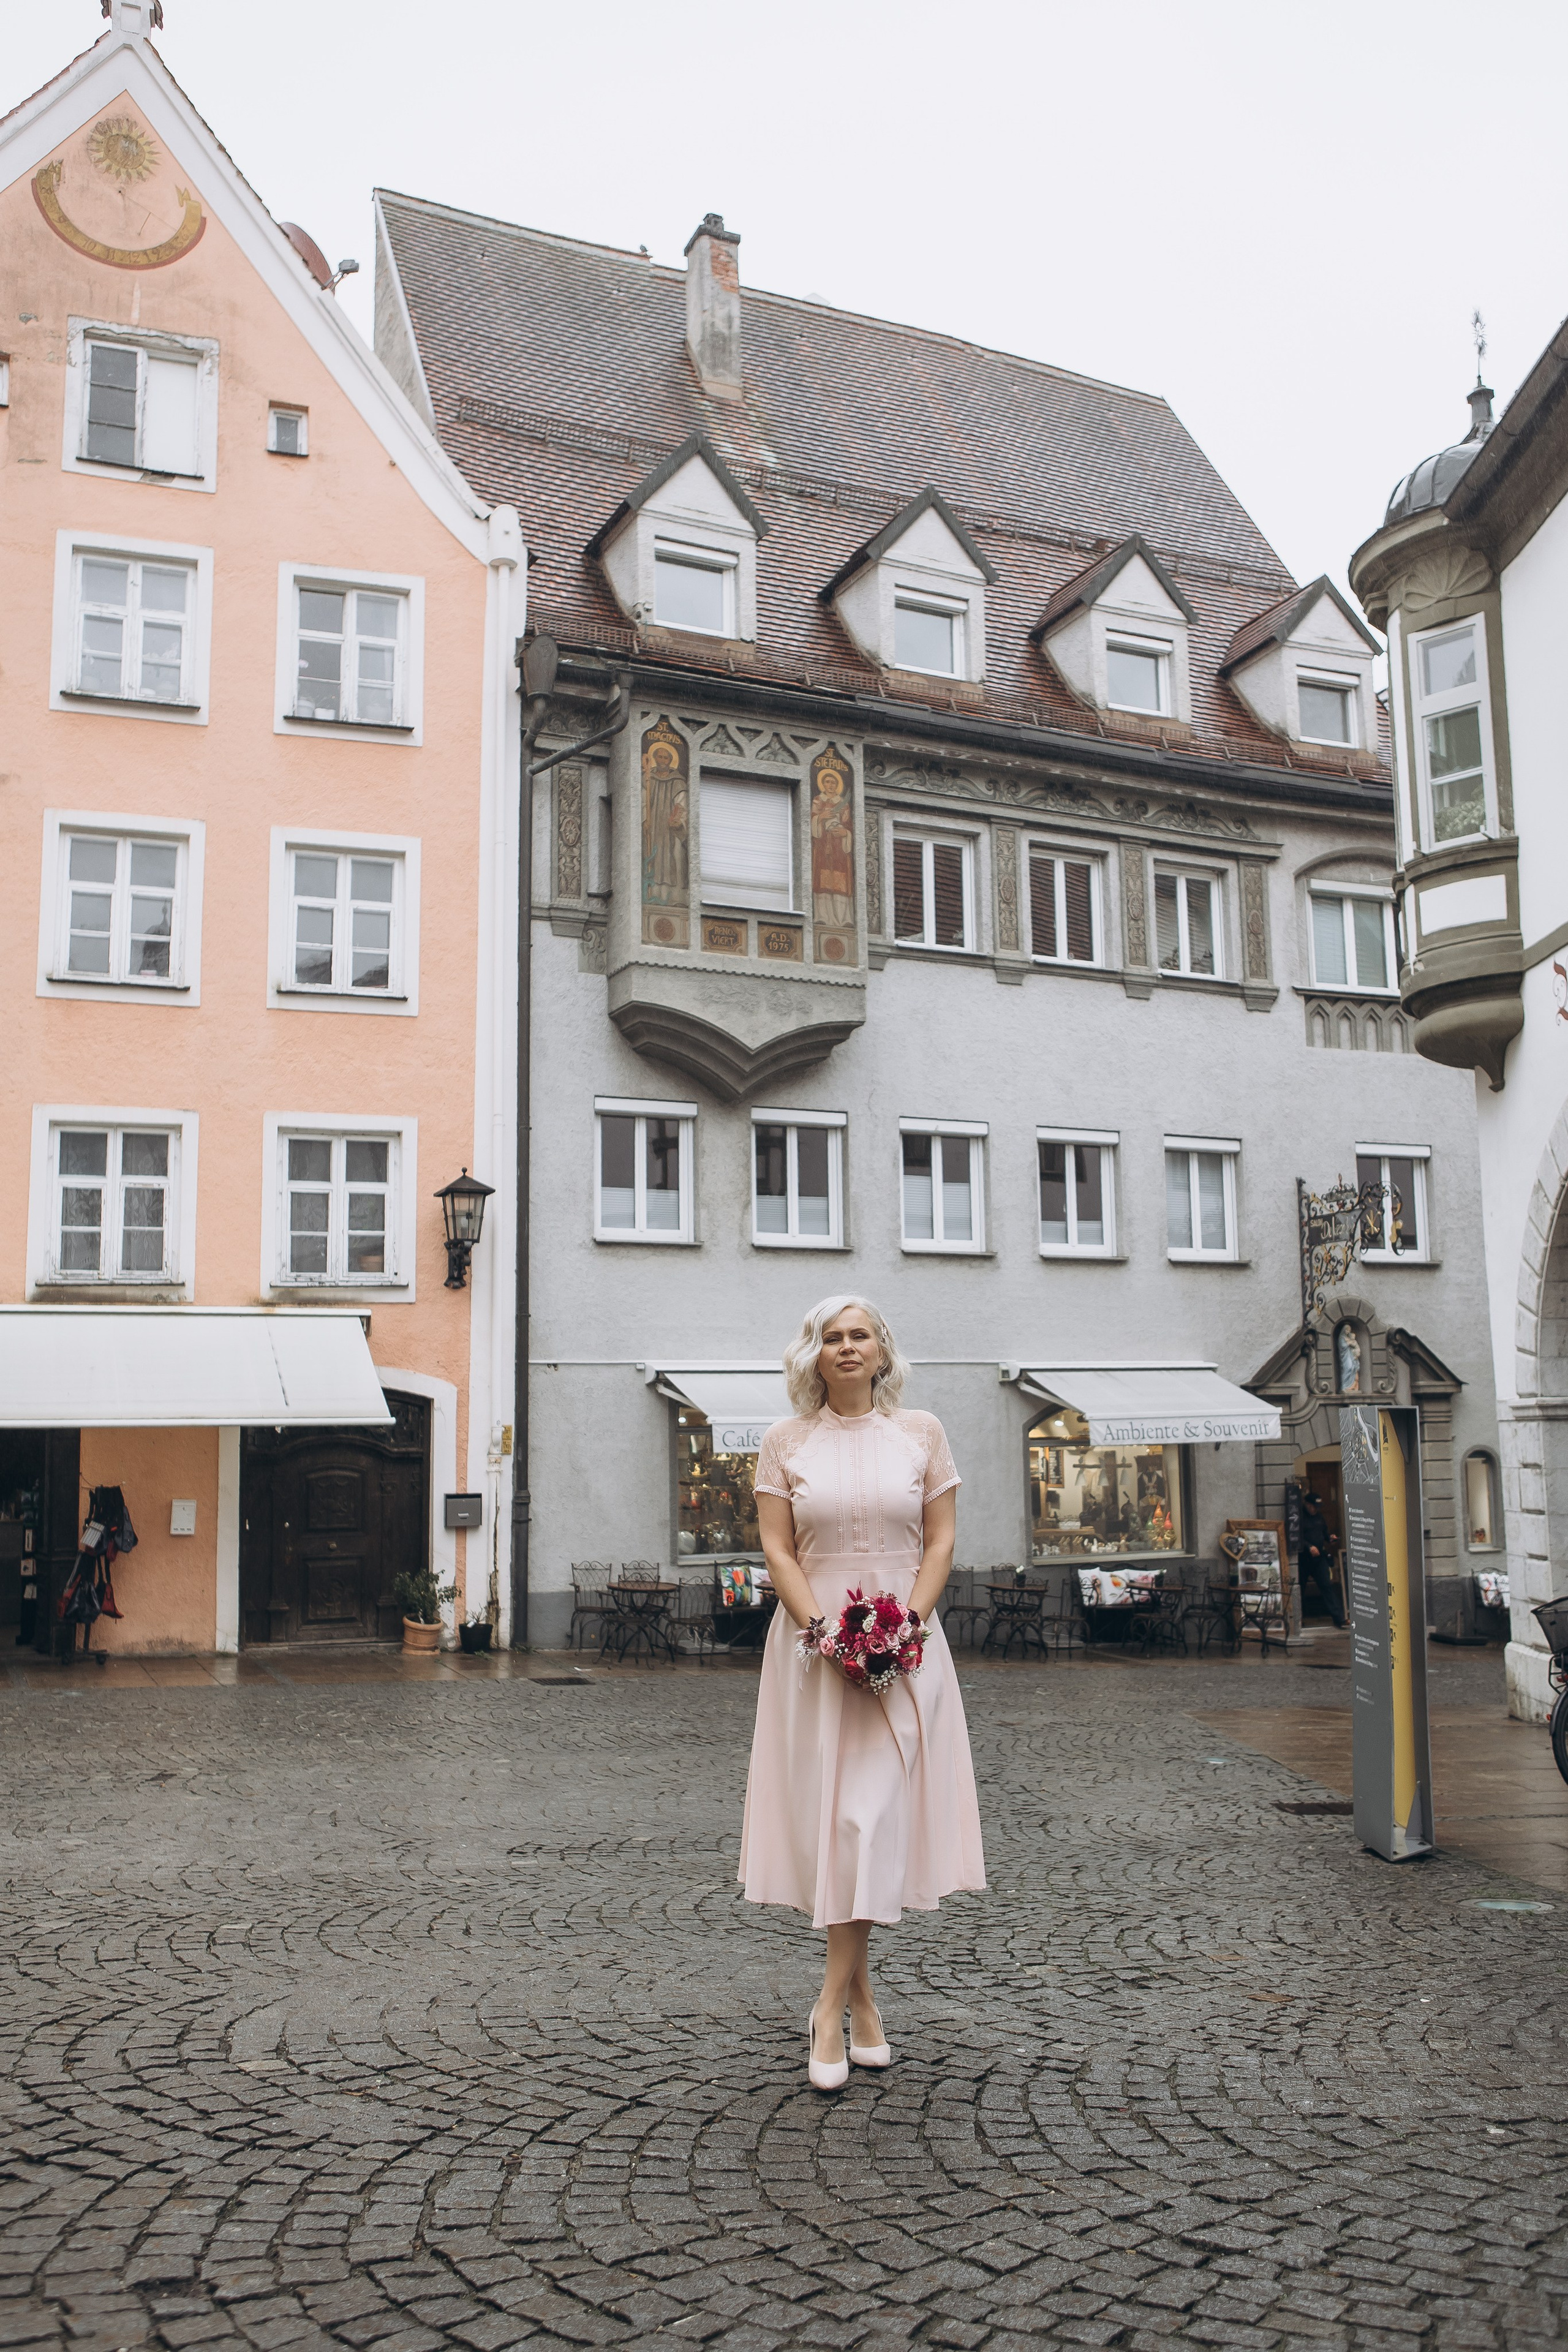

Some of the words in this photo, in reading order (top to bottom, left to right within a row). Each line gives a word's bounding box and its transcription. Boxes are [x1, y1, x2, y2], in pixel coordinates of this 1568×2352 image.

[127, 252, 140, 263] 12
[771, 933, 790, 942] A.D.
[767, 941, 789, 952] 1975
[1104, 1421, 1180, 1441] Ambiente
[1183, 1421, 1200, 1438] &
[1204, 1419, 1270, 1438] Souvenir
[722, 1429, 760, 1447] Café
